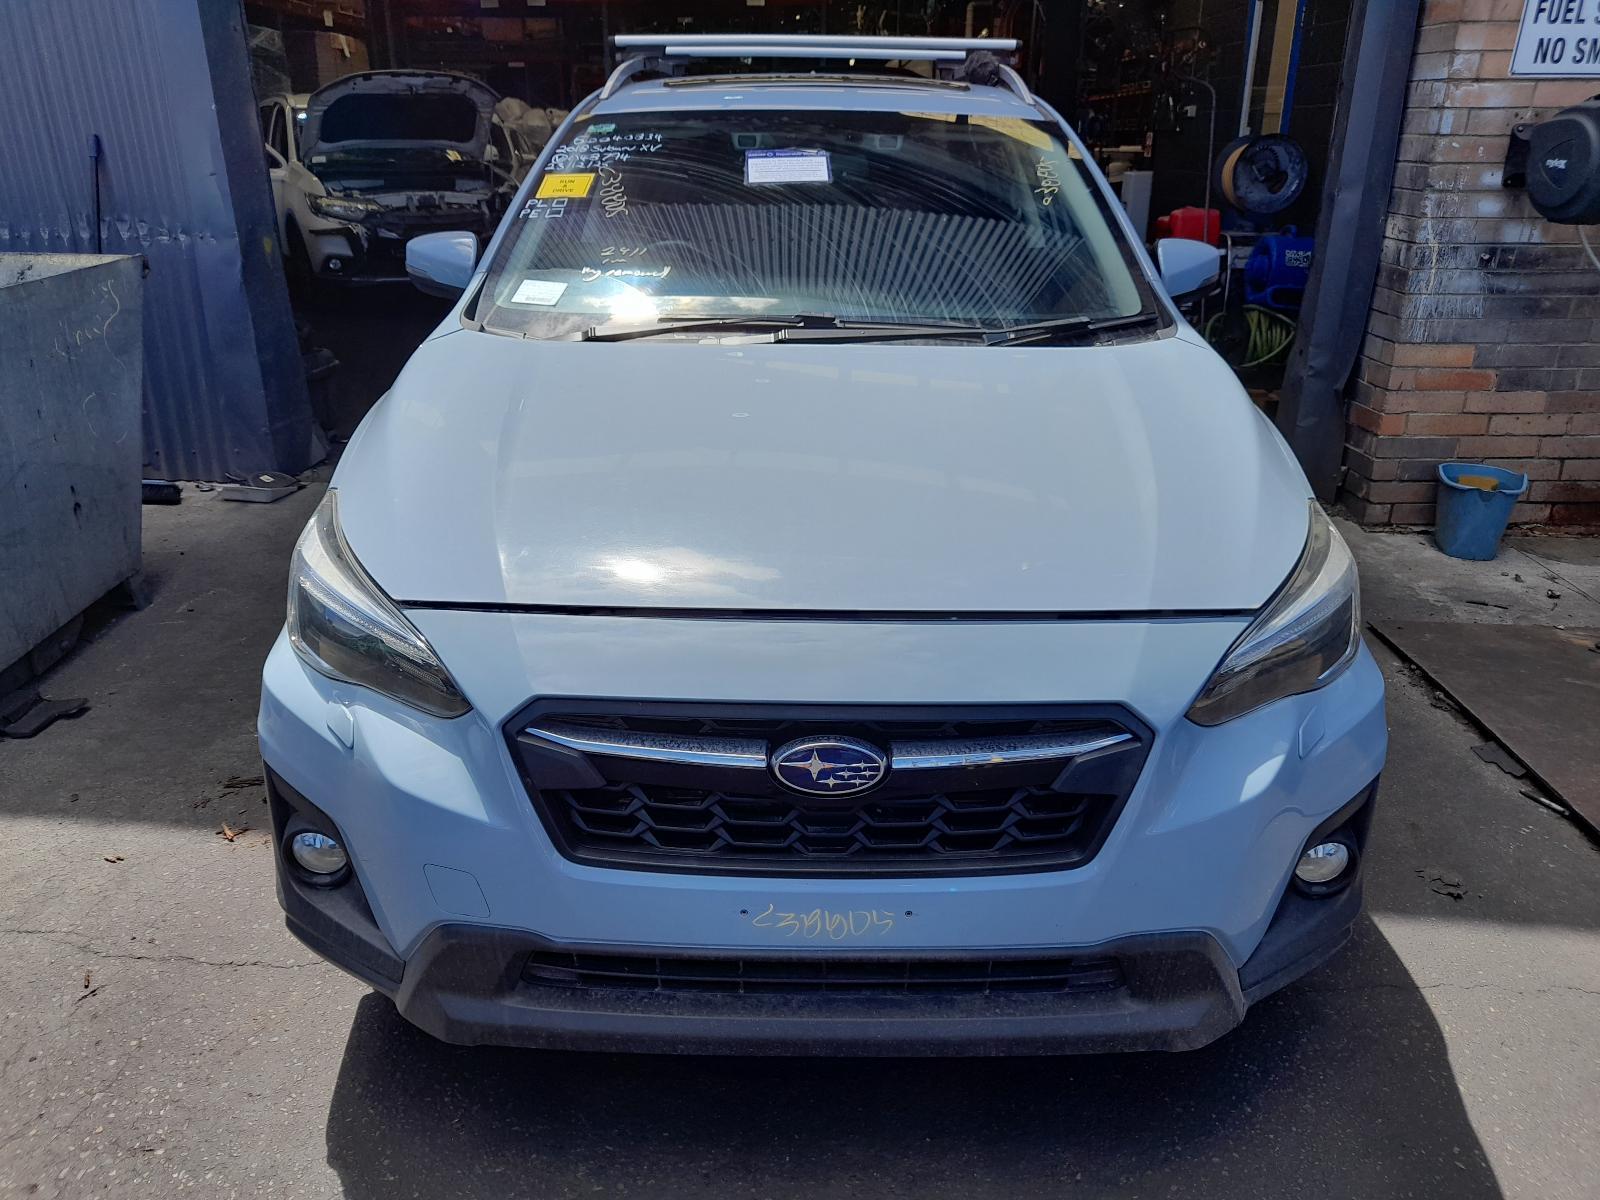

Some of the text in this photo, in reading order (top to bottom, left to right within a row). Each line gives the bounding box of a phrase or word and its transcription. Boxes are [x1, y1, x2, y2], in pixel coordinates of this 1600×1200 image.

[1533, 0, 1585, 24] FUEL
[1533, 37, 1566, 64] NO
[639, 143, 662, 152] XV
